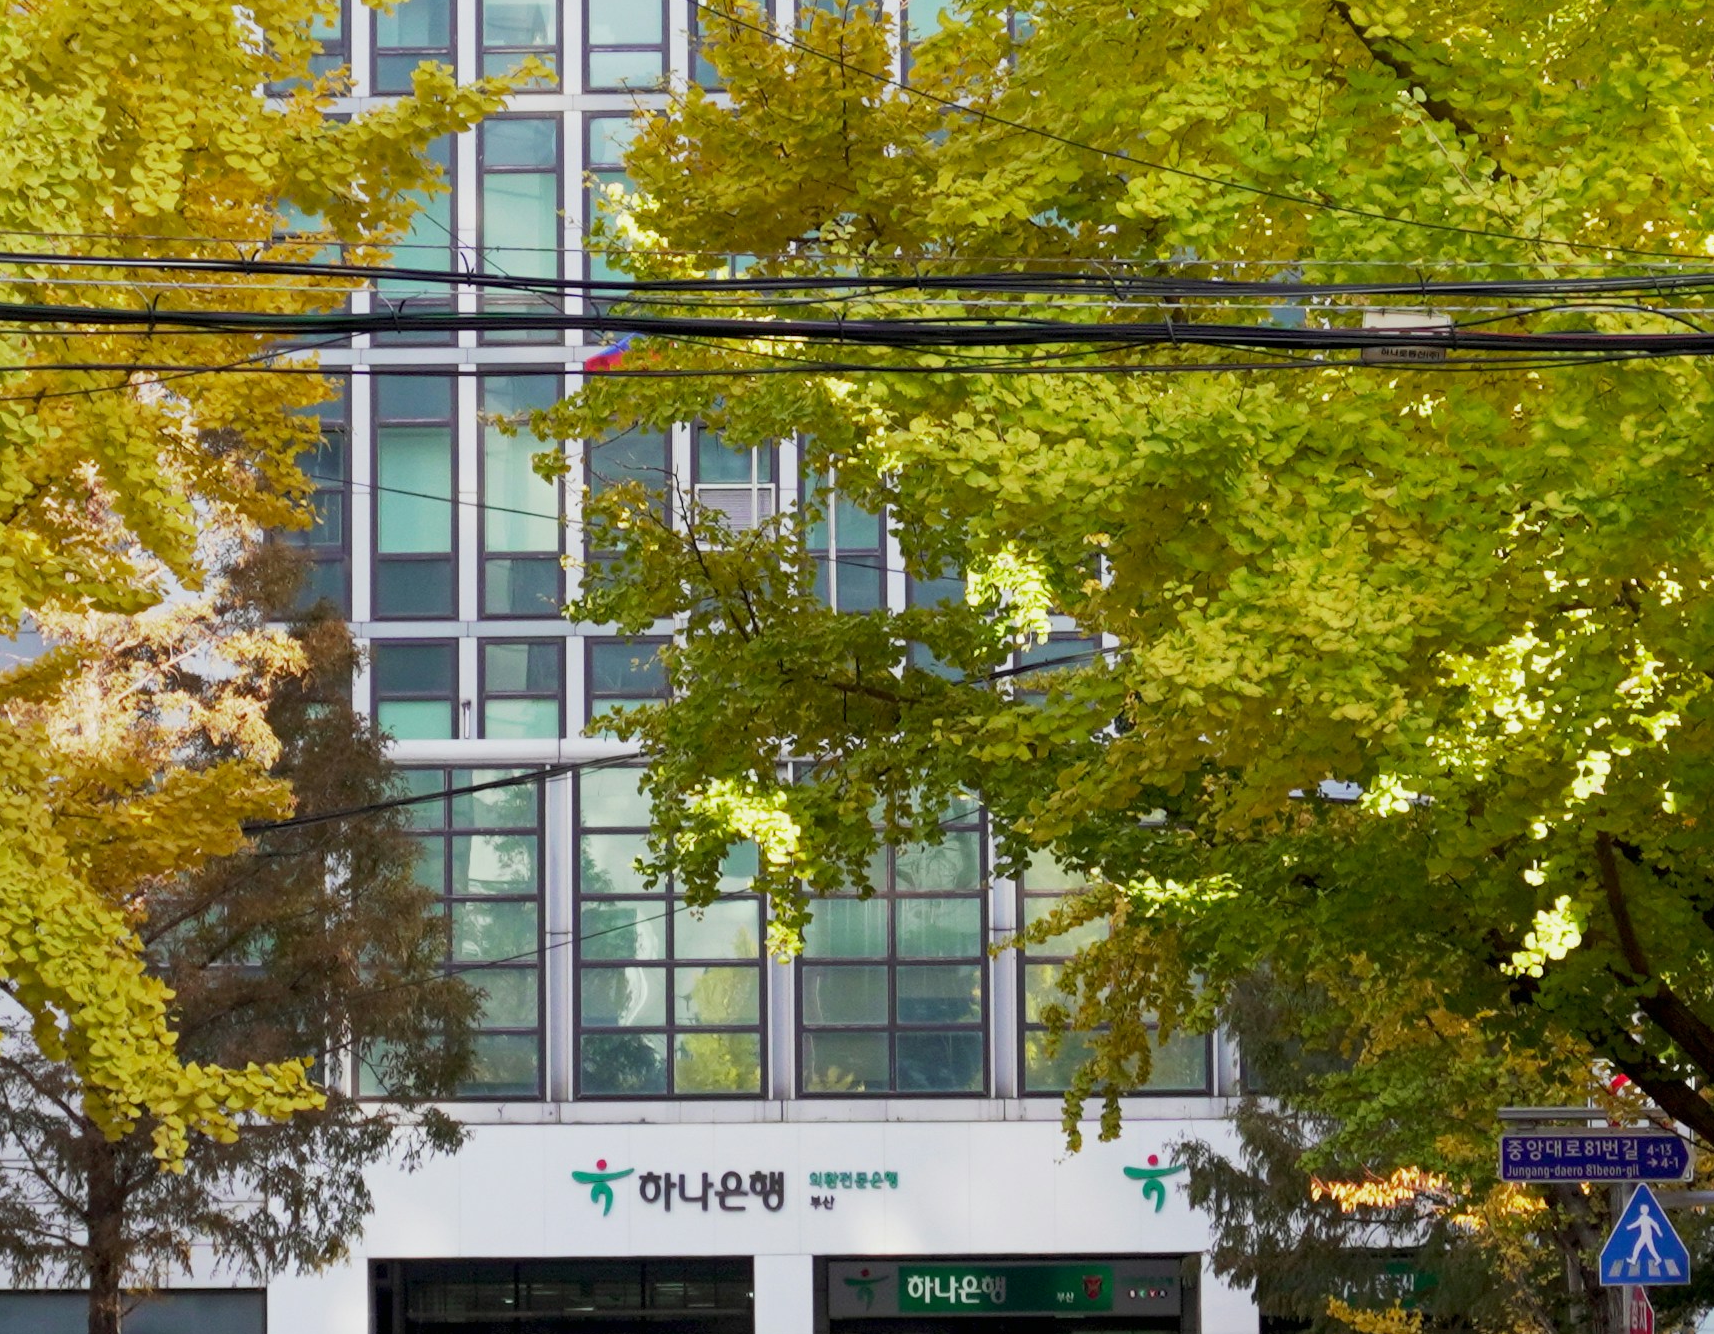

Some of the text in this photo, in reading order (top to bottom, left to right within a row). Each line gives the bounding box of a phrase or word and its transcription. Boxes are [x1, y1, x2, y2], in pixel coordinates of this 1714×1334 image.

[1507, 1139, 1672, 1161] 중앙대로81번길 4-13
[1507, 1164, 1583, 1180] Jungang-daero
[1586, 1163, 1639, 1178] 81beon-gil
[639, 1170, 785, 1212] 하나은행
[810, 1195, 835, 1210] 부산
[907, 1275, 1007, 1304] 하나은행
